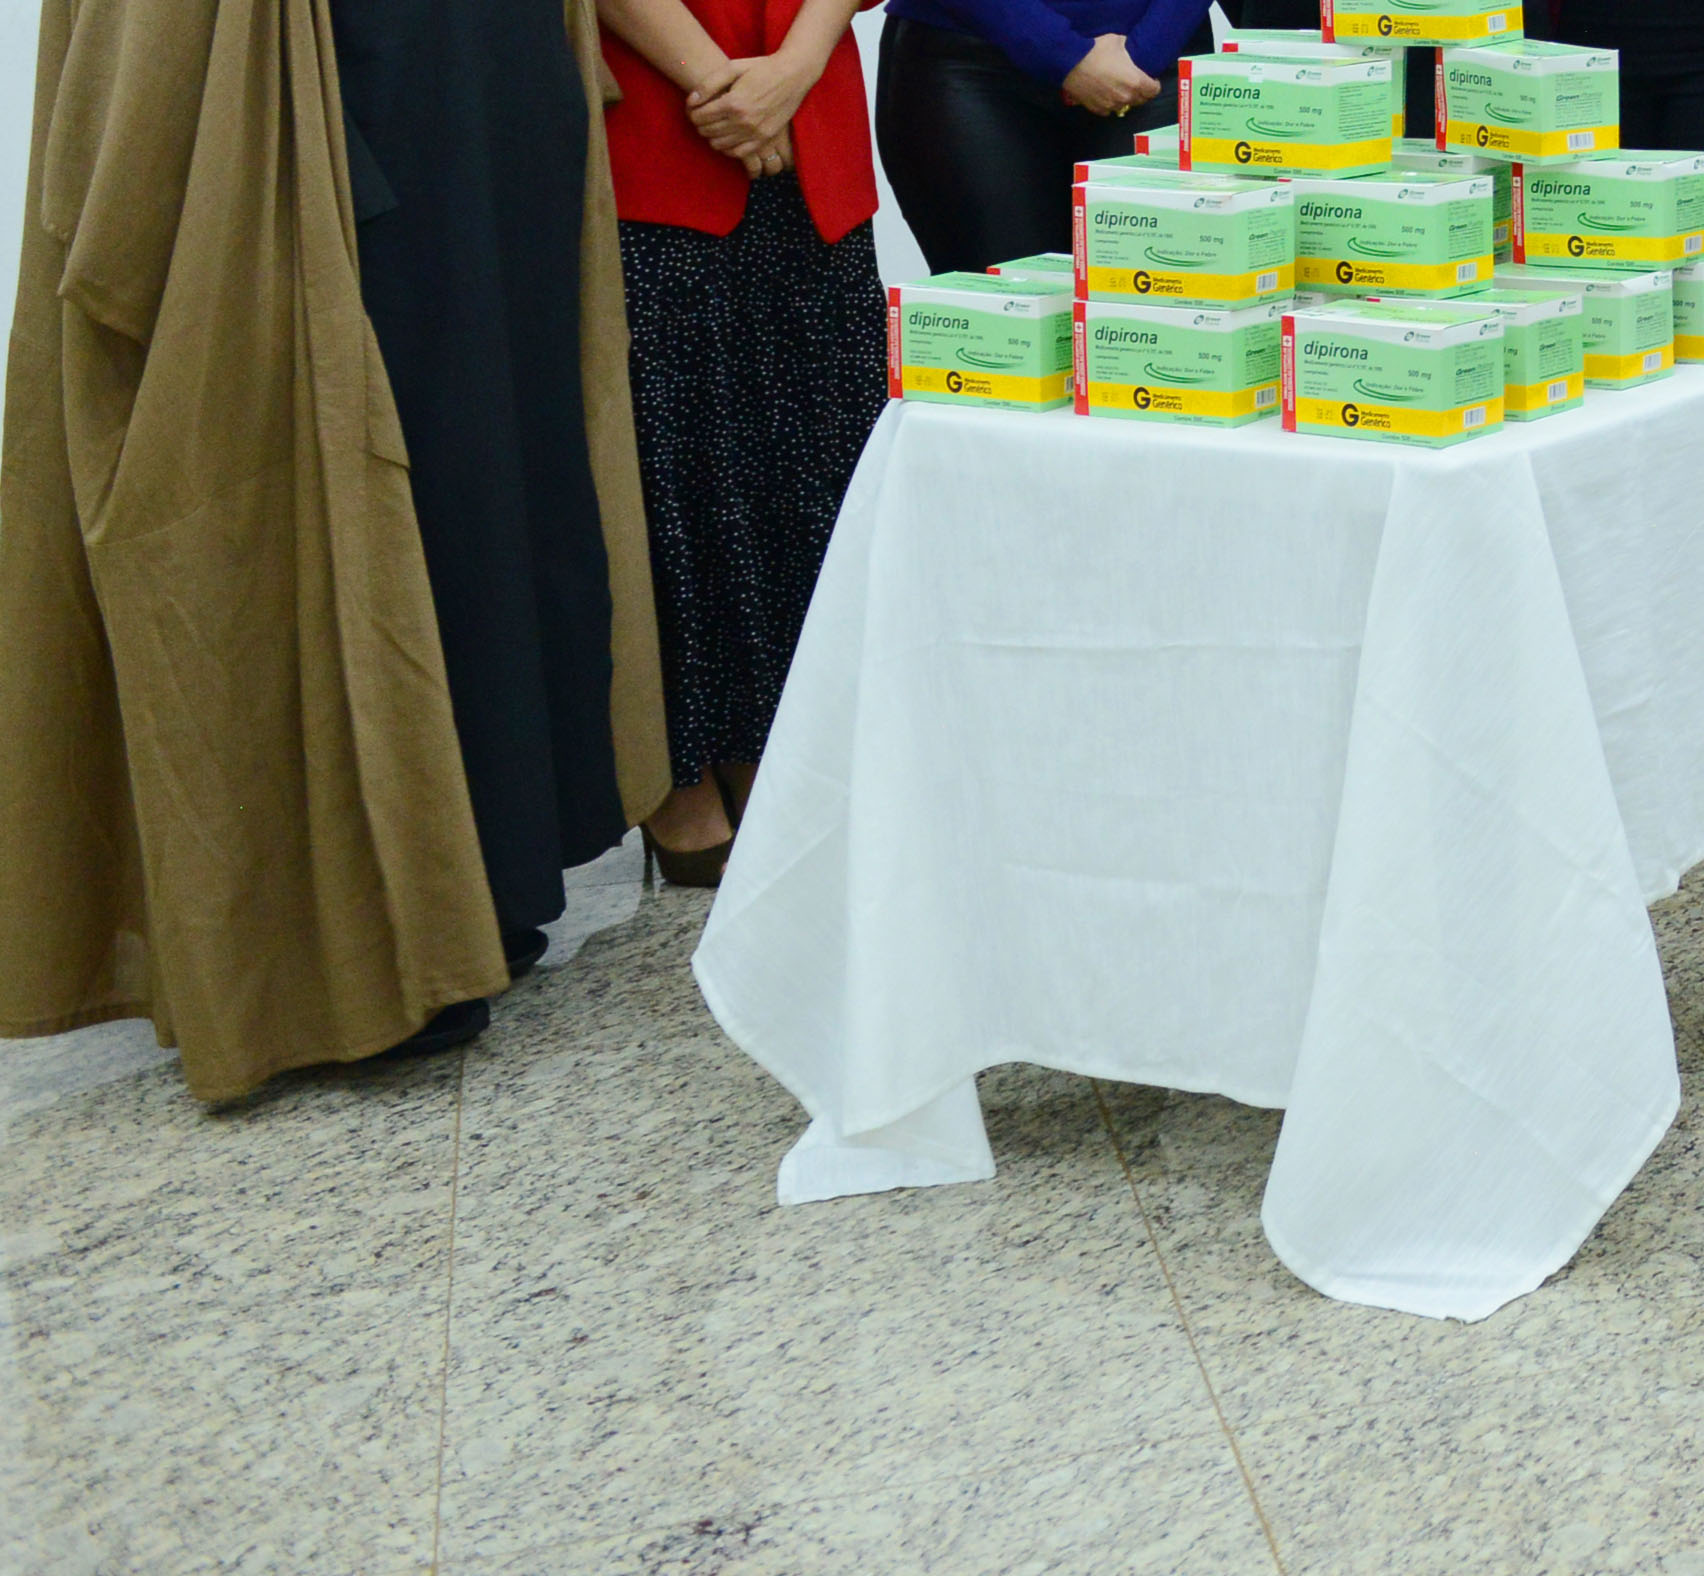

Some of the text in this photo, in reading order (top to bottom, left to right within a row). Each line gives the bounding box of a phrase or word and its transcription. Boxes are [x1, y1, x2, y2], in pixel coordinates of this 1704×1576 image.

[1378, 15, 1392, 36] G
[1394, 25, 1420, 35] Genérico
[1450, 69, 1492, 86] dipirona
[1200, 83, 1261, 101] dipirona
[1312, 108, 1322, 116] mg
[1235, 141, 1252, 164] G
[1253, 153, 1283, 163] Genérico
[1531, 180, 1591, 197] dipirona
[1300, 202, 1362, 219] dipirona
[1642, 202, 1653, 210] mg
[1095, 211, 1158, 229] dipirona
[1415, 227, 1425, 235] mg
[1213, 236, 1224, 245] mg
[1568, 236, 1584, 257] G
[1586, 246, 1615, 256] Genérico
[1336, 261, 1353, 284] G
[1355, 273, 1384, 284] Genérico
[1133, 271, 1151, 293] G
[1153, 283, 1183, 294] Genérico
[909, 312, 969, 329] dipirona
[1095, 326, 1158, 344] dipirona
[1211, 354, 1222, 362] mg
[1304, 341, 1368, 360] dipirona
[1133, 387, 1151, 410] G
[1153, 399, 1182, 410] Genérico
[1342, 404, 1359, 427] G
[1361, 417, 1391, 429] Genérico
